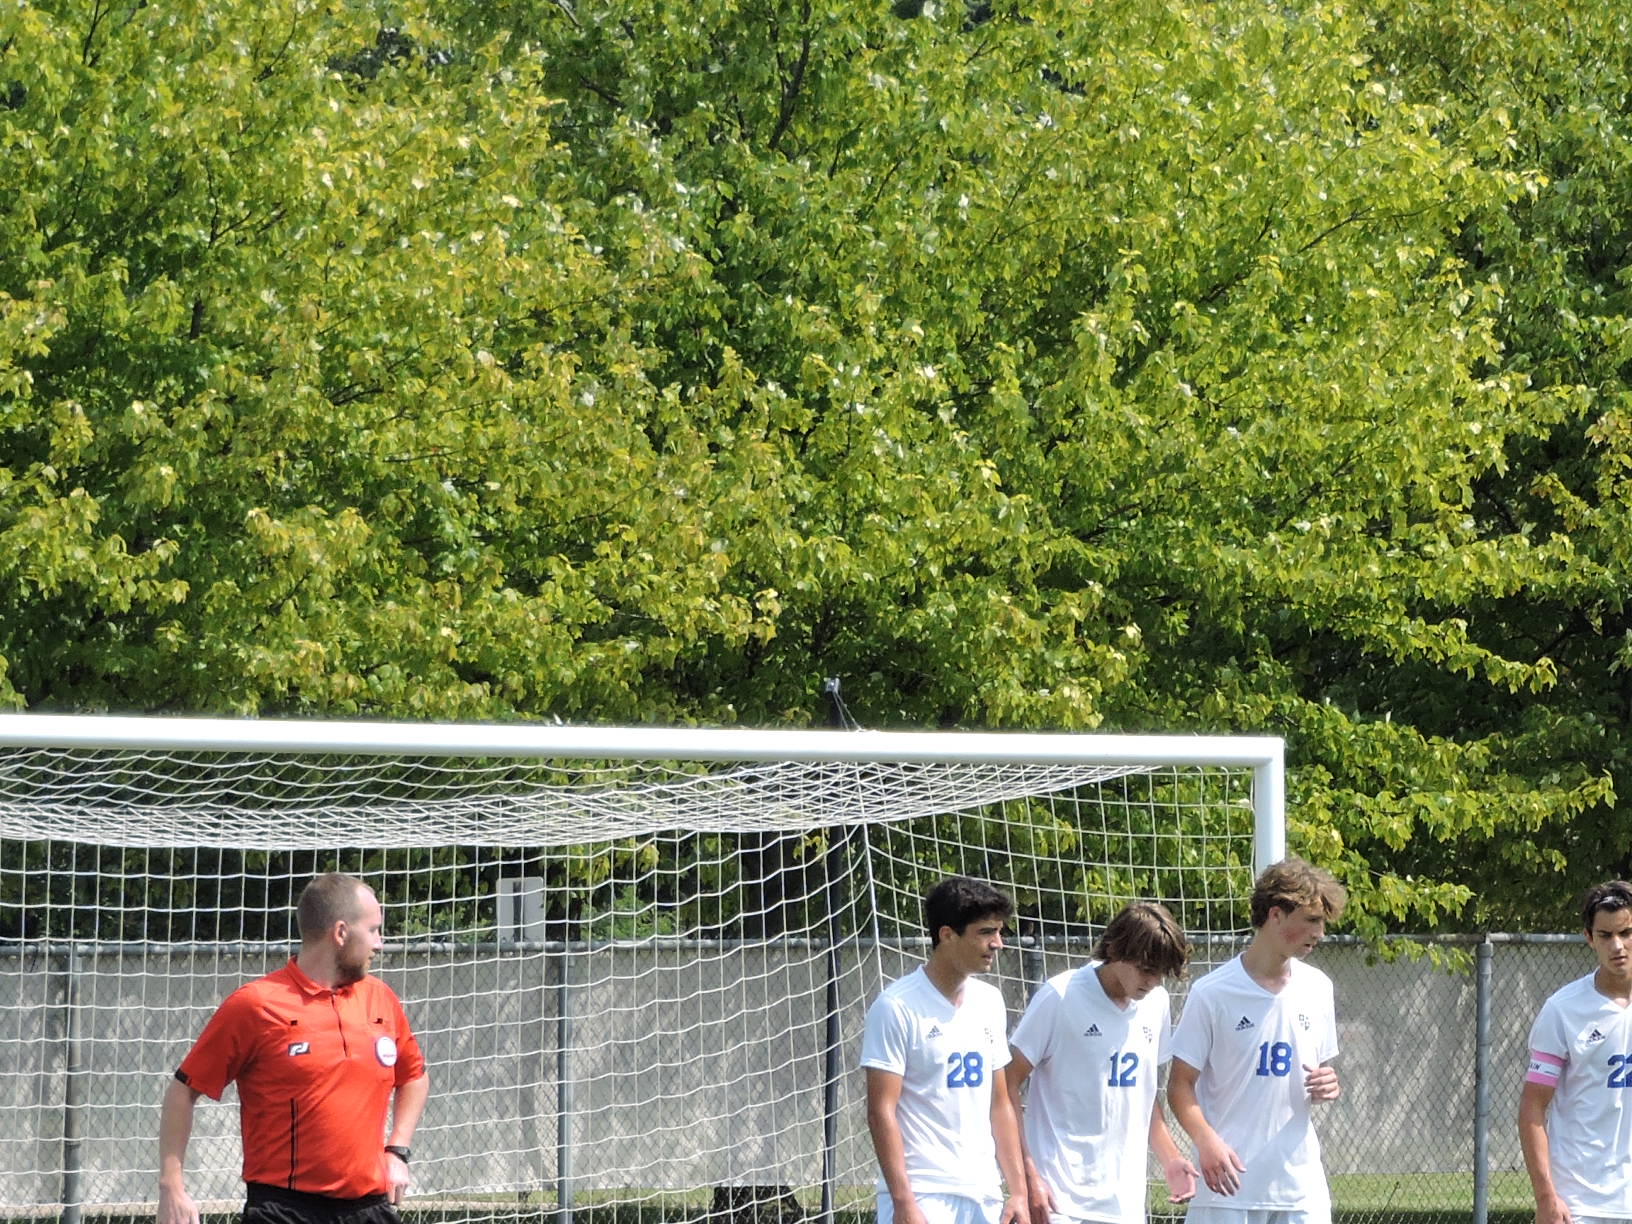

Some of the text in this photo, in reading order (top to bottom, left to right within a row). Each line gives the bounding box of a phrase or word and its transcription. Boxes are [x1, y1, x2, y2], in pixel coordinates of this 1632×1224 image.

[946, 1051, 984, 1089] 28
[1107, 1051, 1139, 1088] 12
[1255, 1041, 1292, 1077] 18
